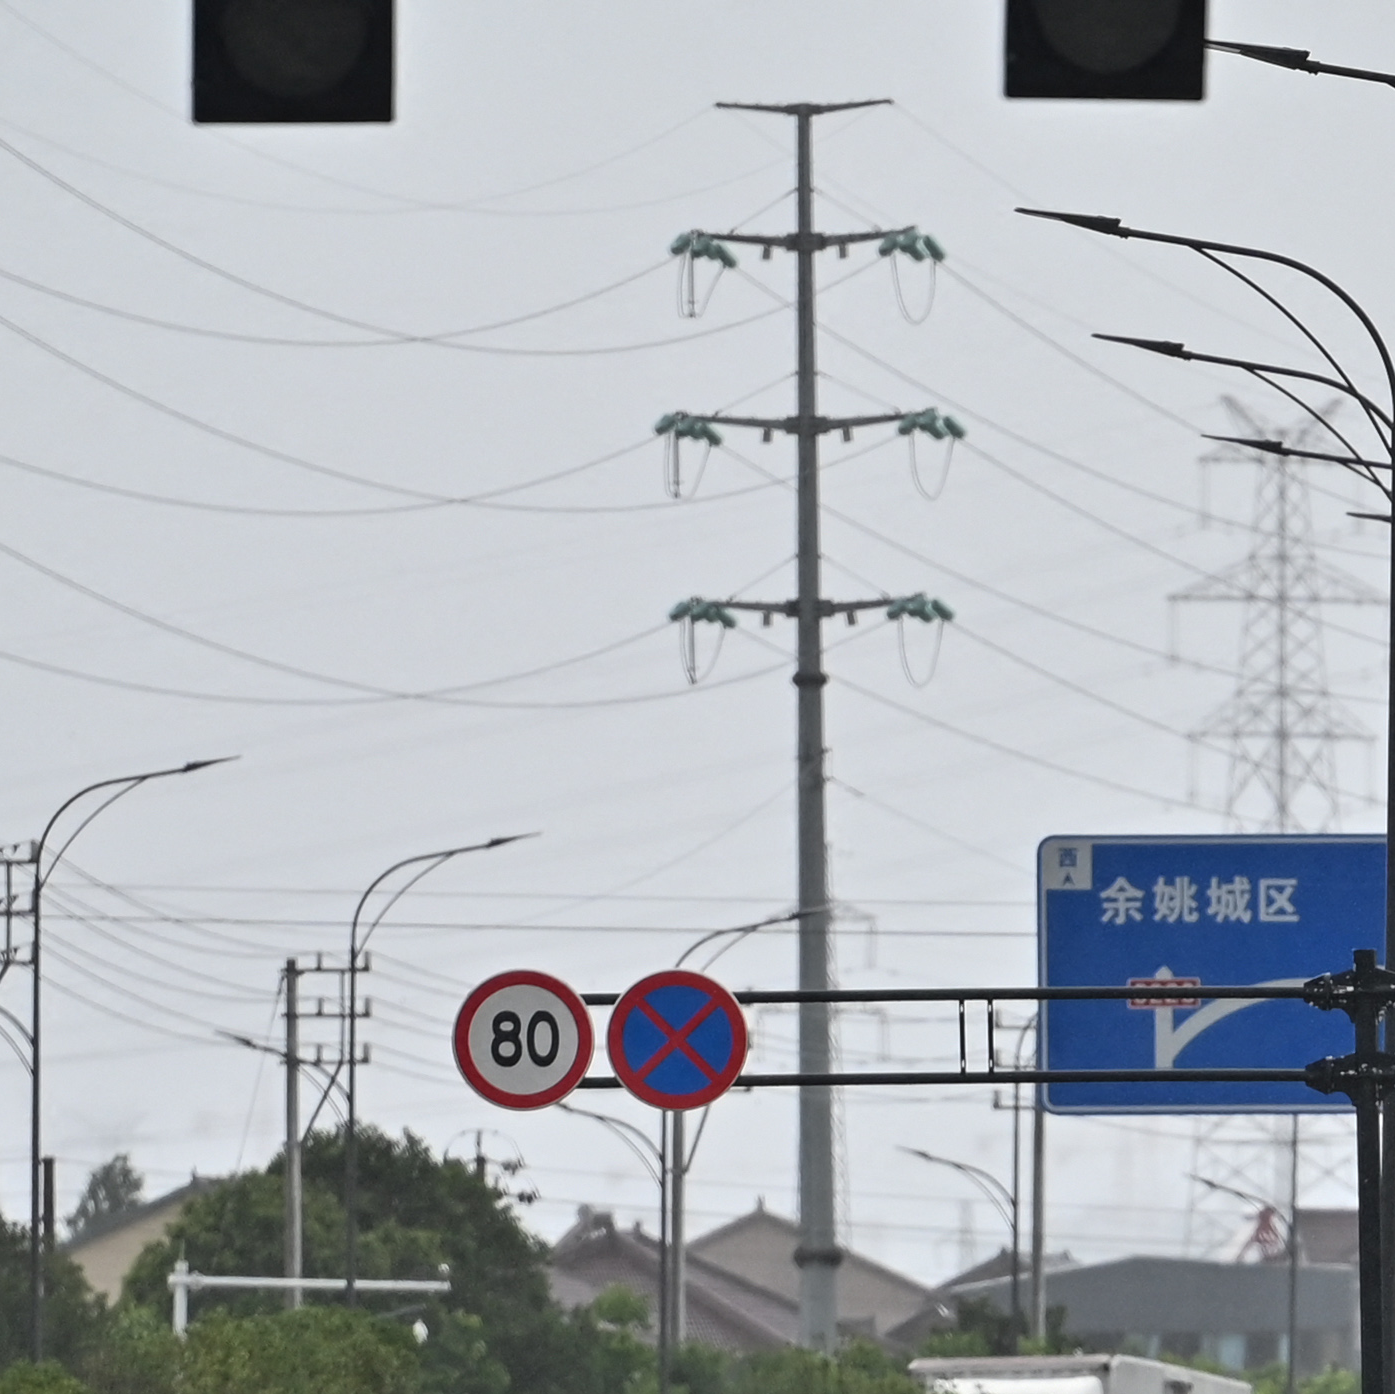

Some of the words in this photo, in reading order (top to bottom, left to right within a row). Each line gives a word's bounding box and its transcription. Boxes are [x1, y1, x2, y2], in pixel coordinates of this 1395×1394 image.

[1100, 875, 1300, 925] 余姚城区
[491, 1010, 560, 1067] 80
